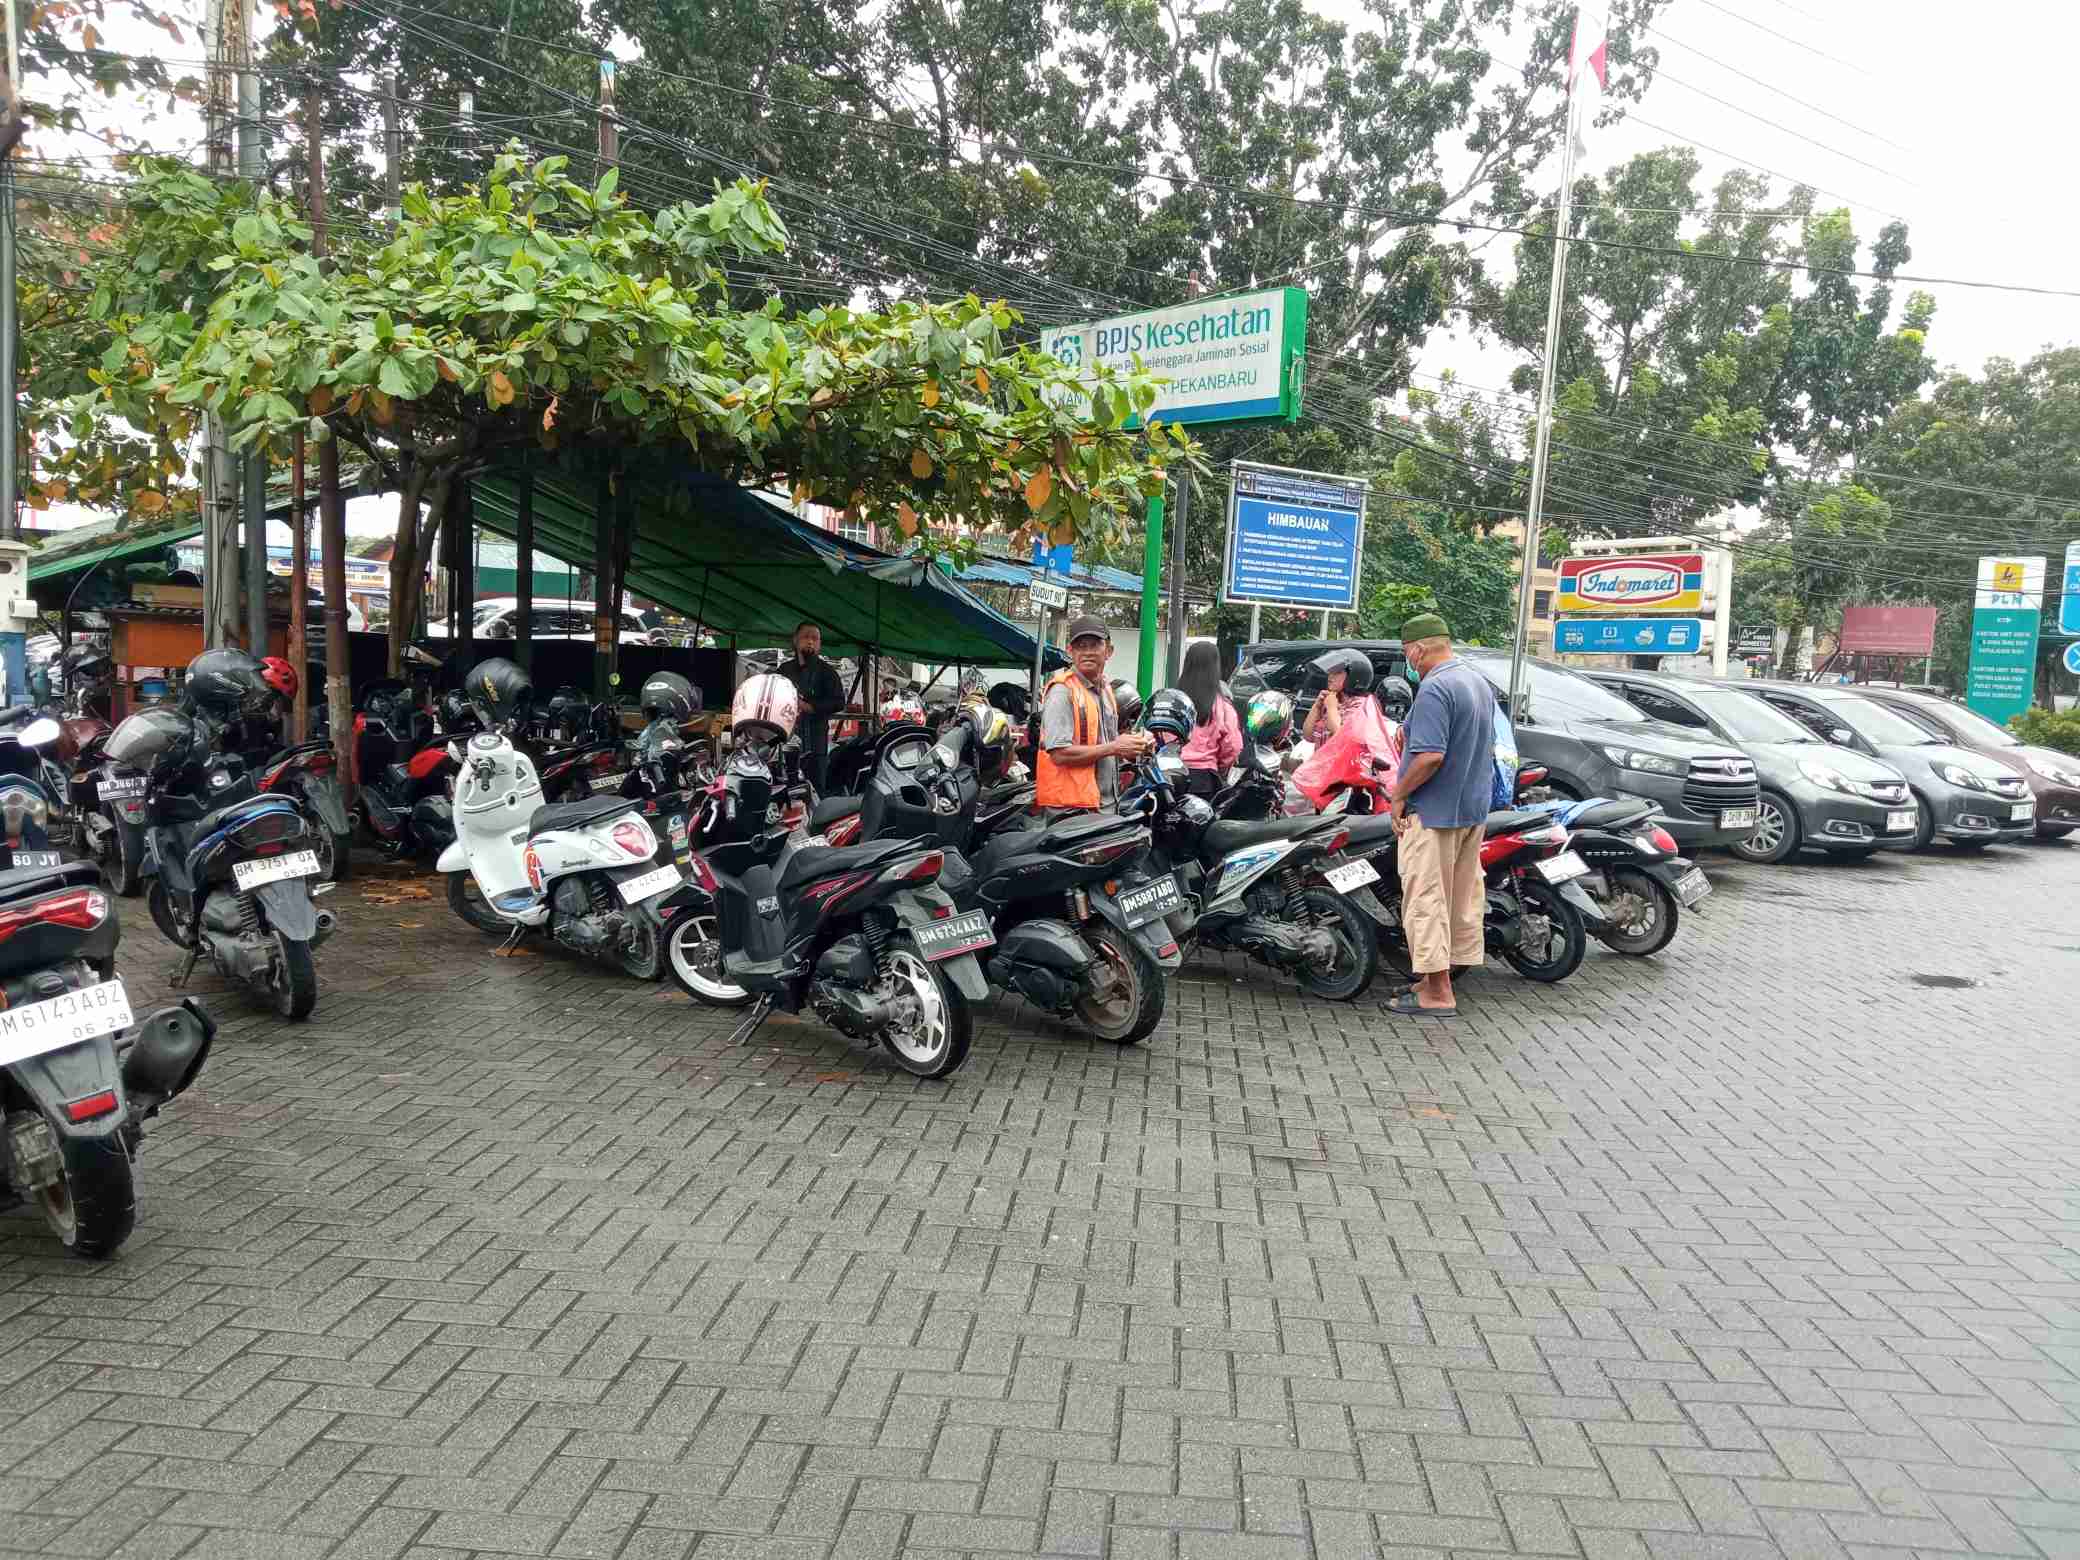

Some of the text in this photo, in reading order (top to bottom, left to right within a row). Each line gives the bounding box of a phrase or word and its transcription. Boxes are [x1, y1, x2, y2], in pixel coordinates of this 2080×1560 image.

[1096, 305, 1271, 357] BPJS Kesehatan
[1195, 346, 1236, 363] Jaminan
[1239, 341, 1270, 354] Sosial
[1170, 370, 1257, 395] PEKANBARU
[1267, 511, 1329, 532] HIMBAUAN
[1031, 584, 1054, 600] SUDUT
[1583, 573, 1676, 593] Indomaret
[1991, 592, 2023, 606] PLN
[235, 862, 254, 877] BM
